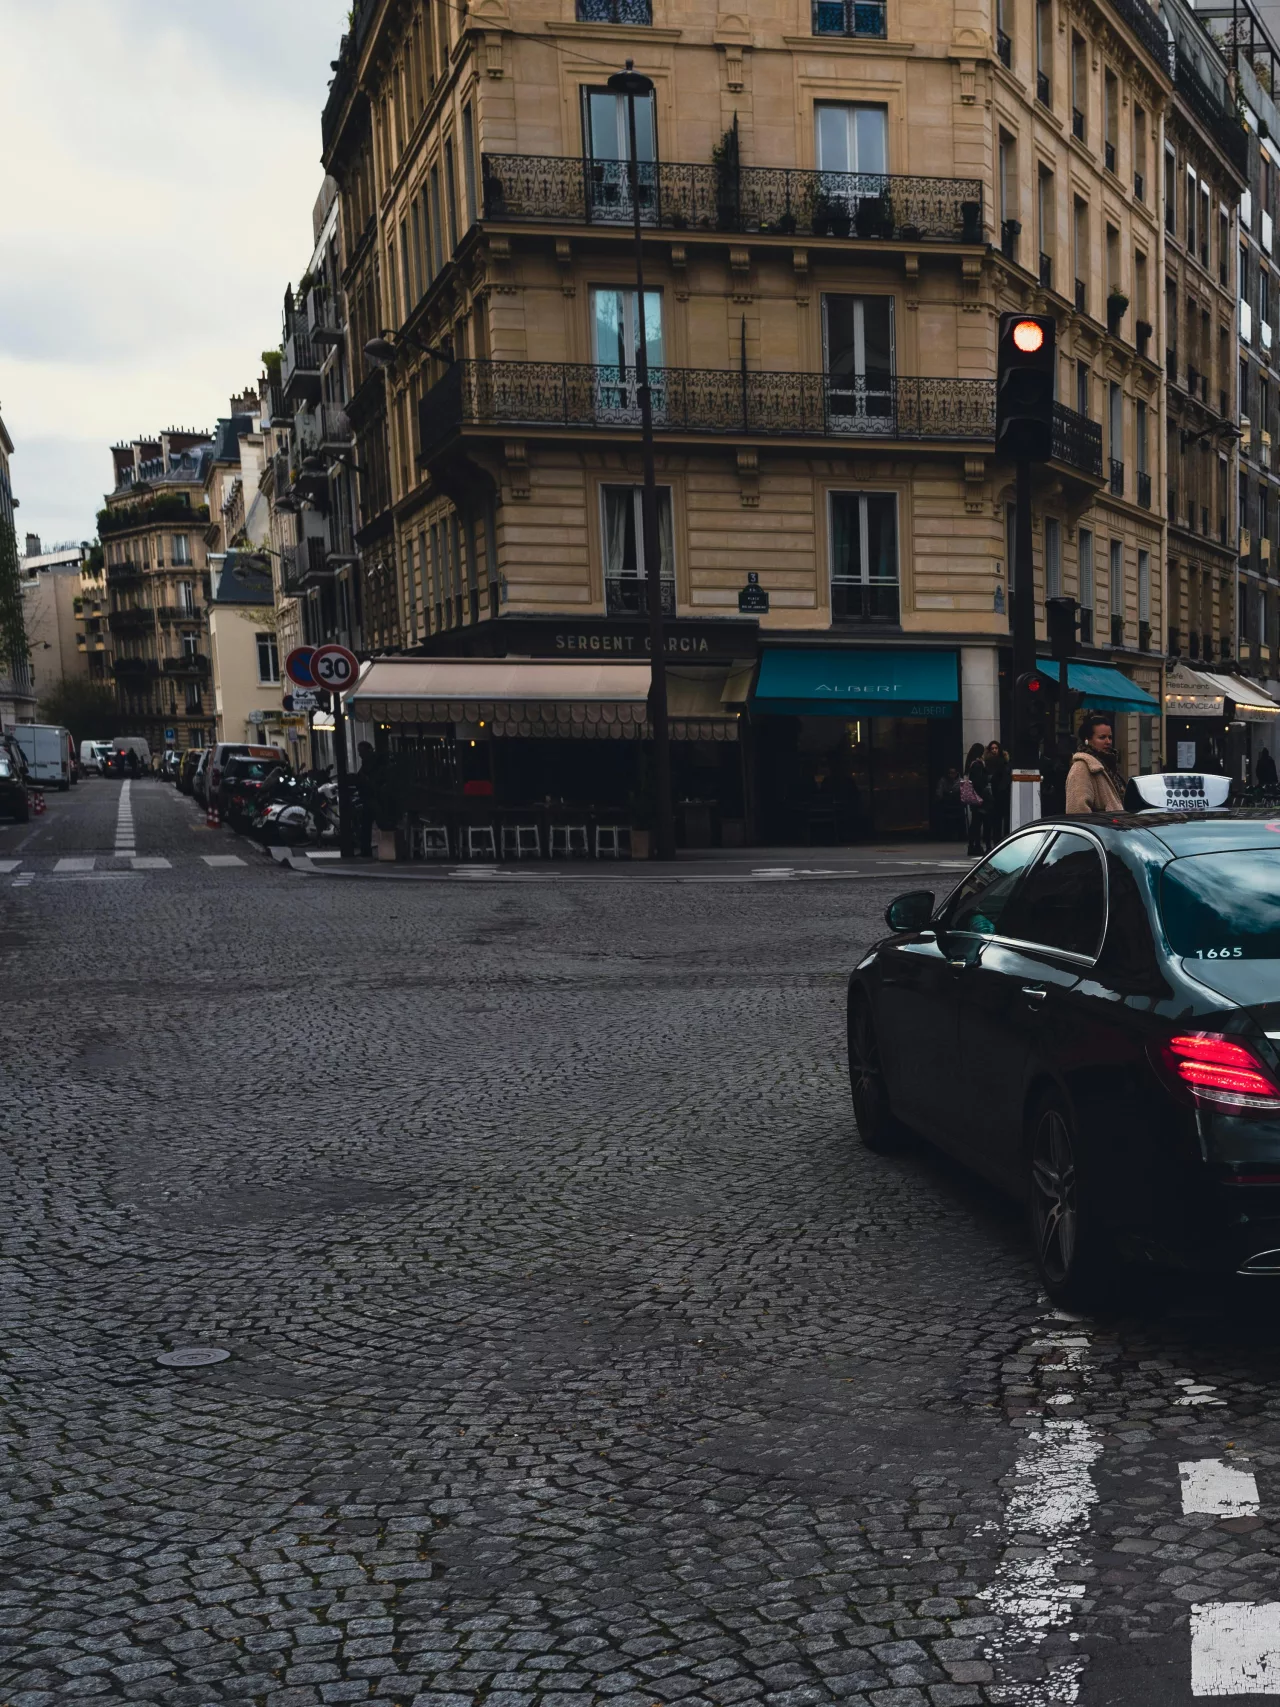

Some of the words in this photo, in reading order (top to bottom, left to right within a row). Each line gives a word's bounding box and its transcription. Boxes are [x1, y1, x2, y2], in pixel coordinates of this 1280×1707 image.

[750, 573, 757, 582] 3
[555, 635, 634, 650] SERGENT
[644, 637, 709, 652] GRCIA
[320, 657, 350, 679] 30
[1166, 682, 1210, 690] Restaurant
[1166, 701, 1176, 709] LE
[1177, 702, 1220, 710] MONCEAU
[910, 706, 947, 715] ALBERT
[1166, 798, 1210, 808] PARISIEN
[1195, 947, 1243, 960] 1665
